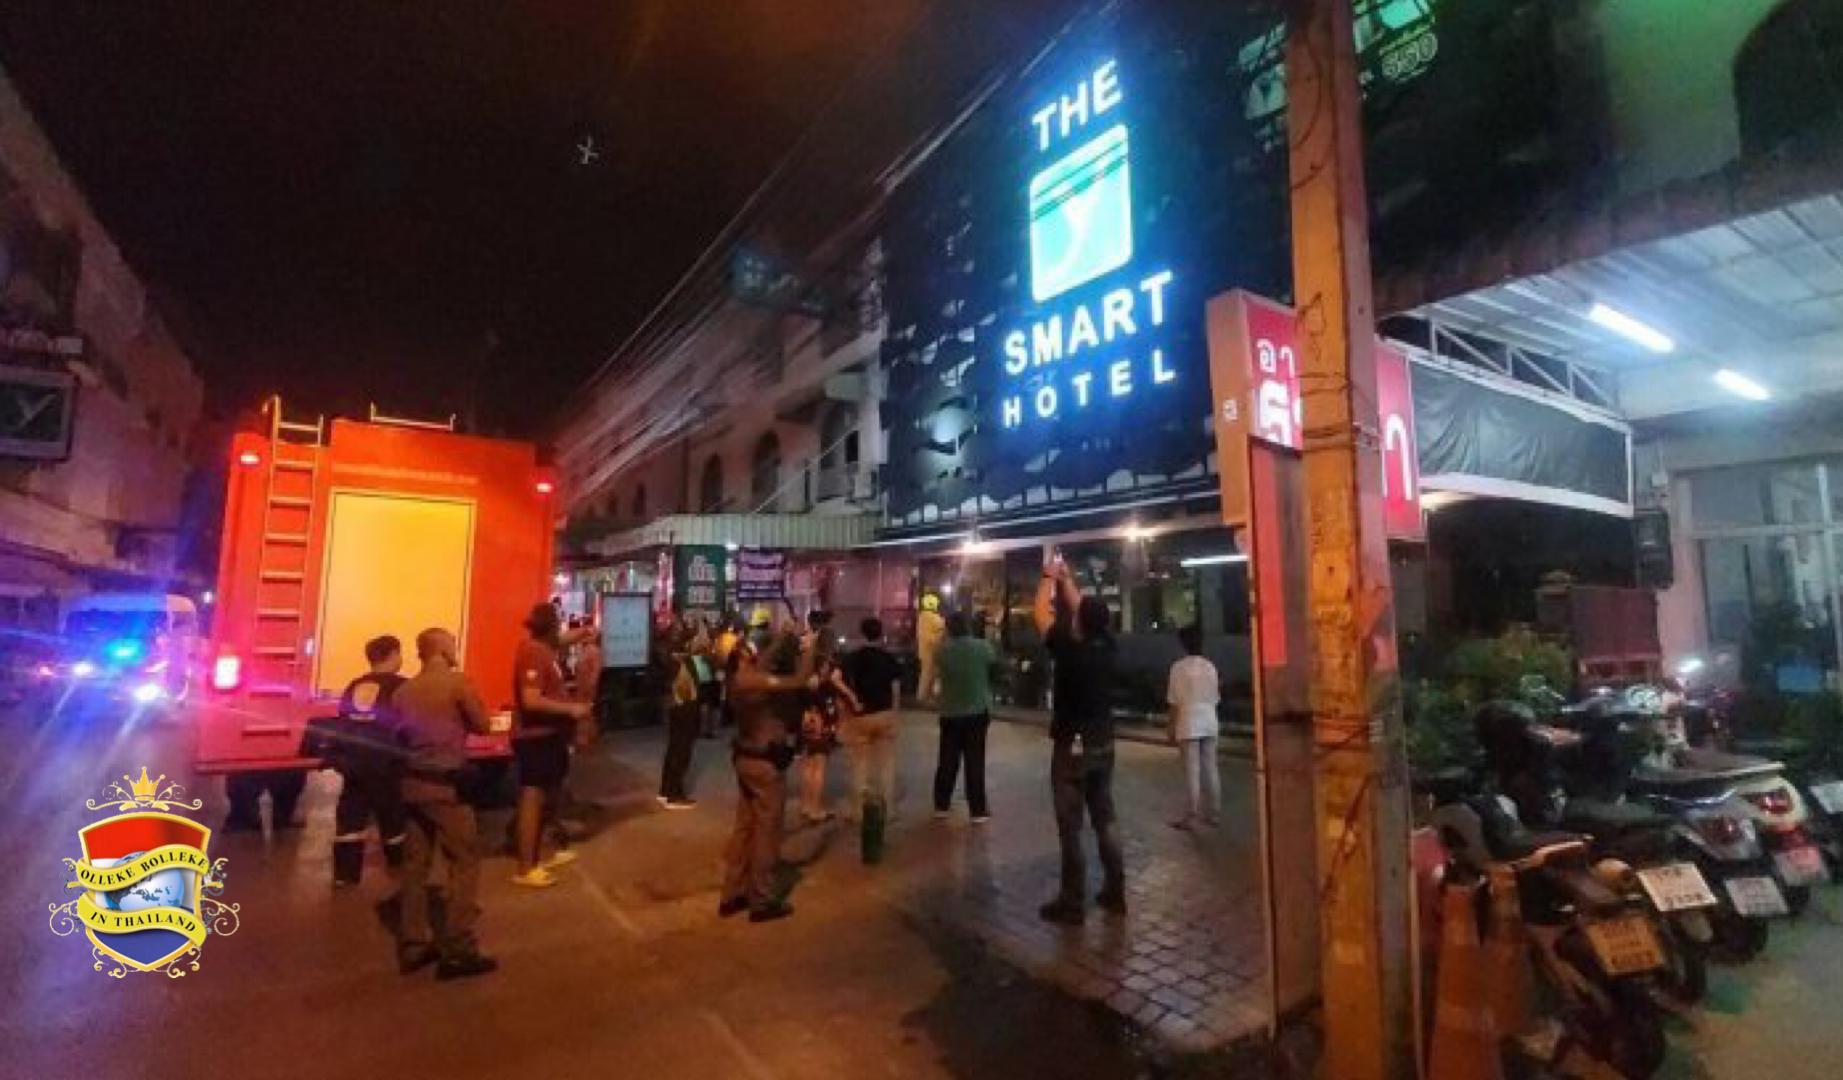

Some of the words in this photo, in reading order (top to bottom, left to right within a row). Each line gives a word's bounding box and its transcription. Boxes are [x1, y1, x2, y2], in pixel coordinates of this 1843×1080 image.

[1031, 58, 1123, 151] THE
[1004, 269, 1173, 376] SMART
[1003, 348, 1176, 428] HOTEL
